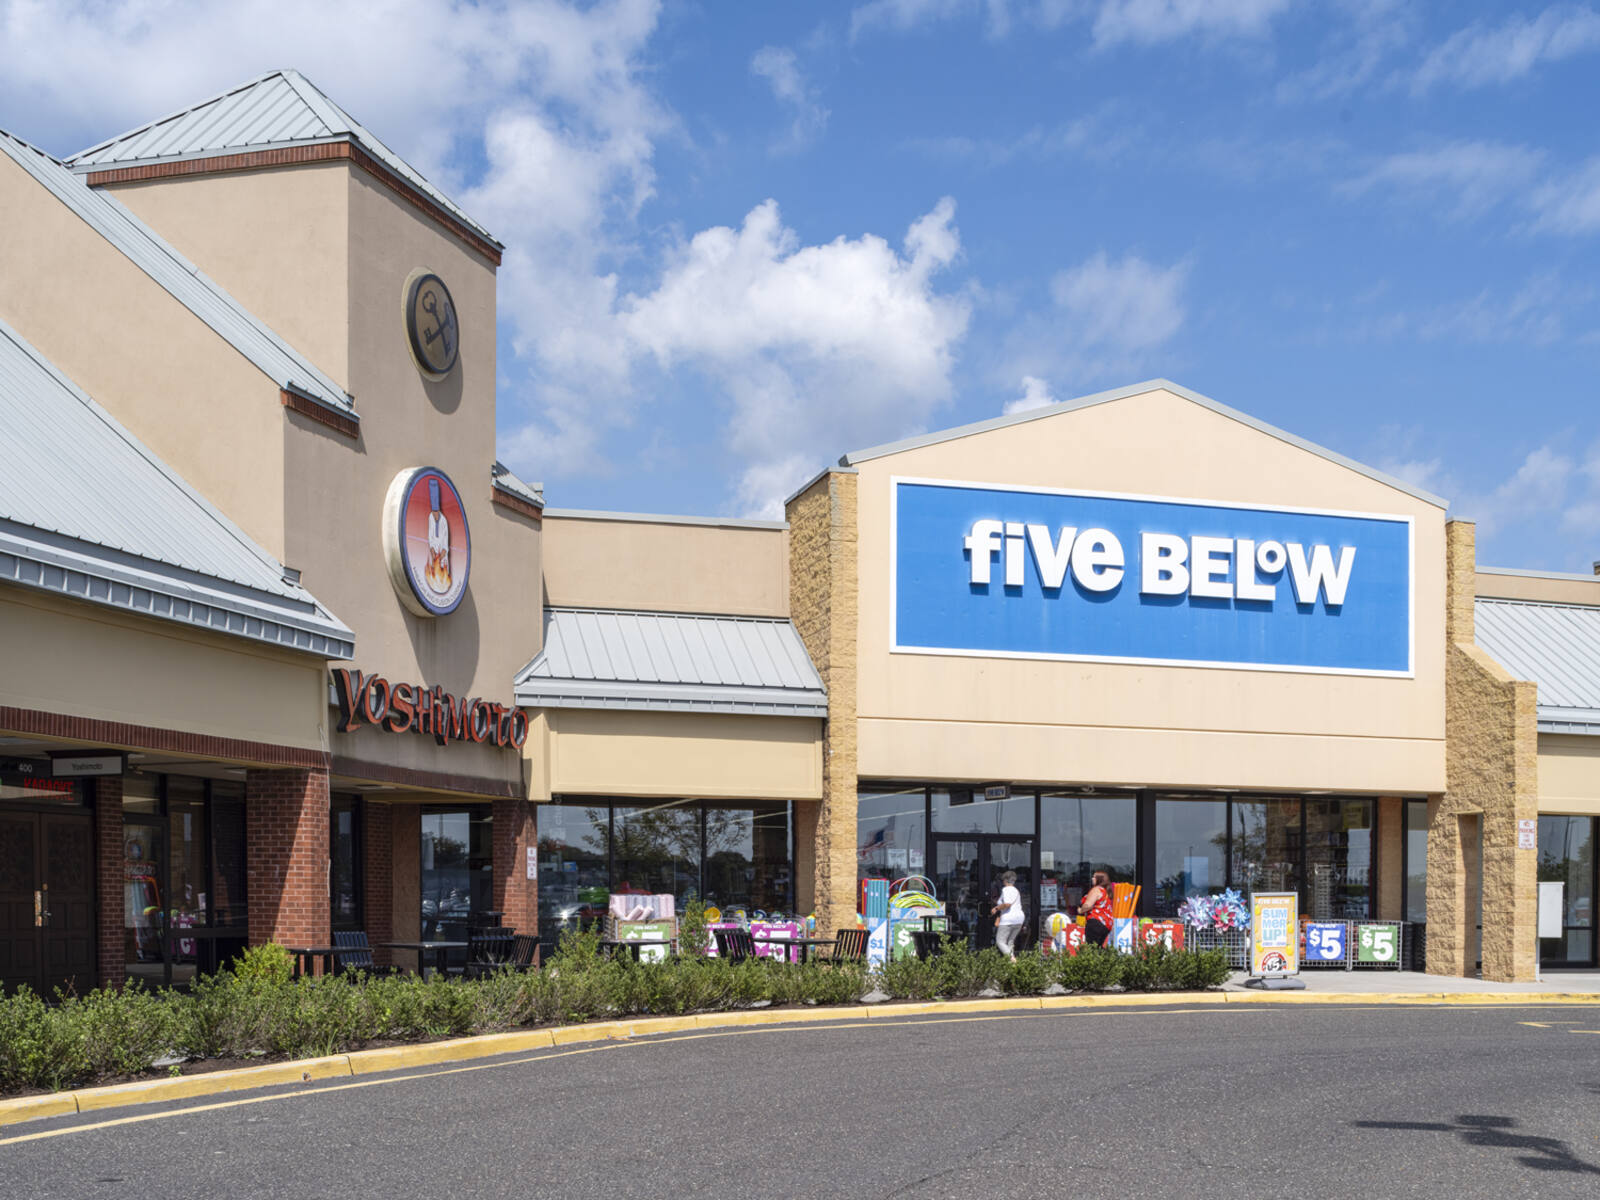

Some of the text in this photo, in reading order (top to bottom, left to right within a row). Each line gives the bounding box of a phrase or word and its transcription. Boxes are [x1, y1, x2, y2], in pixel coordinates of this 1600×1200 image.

[964, 519, 1125, 593] five
[18, 763, 33, 774] 400
[23, 776, 75, 801] KARAOKE
[870, 938, 884, 949] $1
[1309, 928, 1342, 960] $5
[1361, 930, 1394, 961] $5
